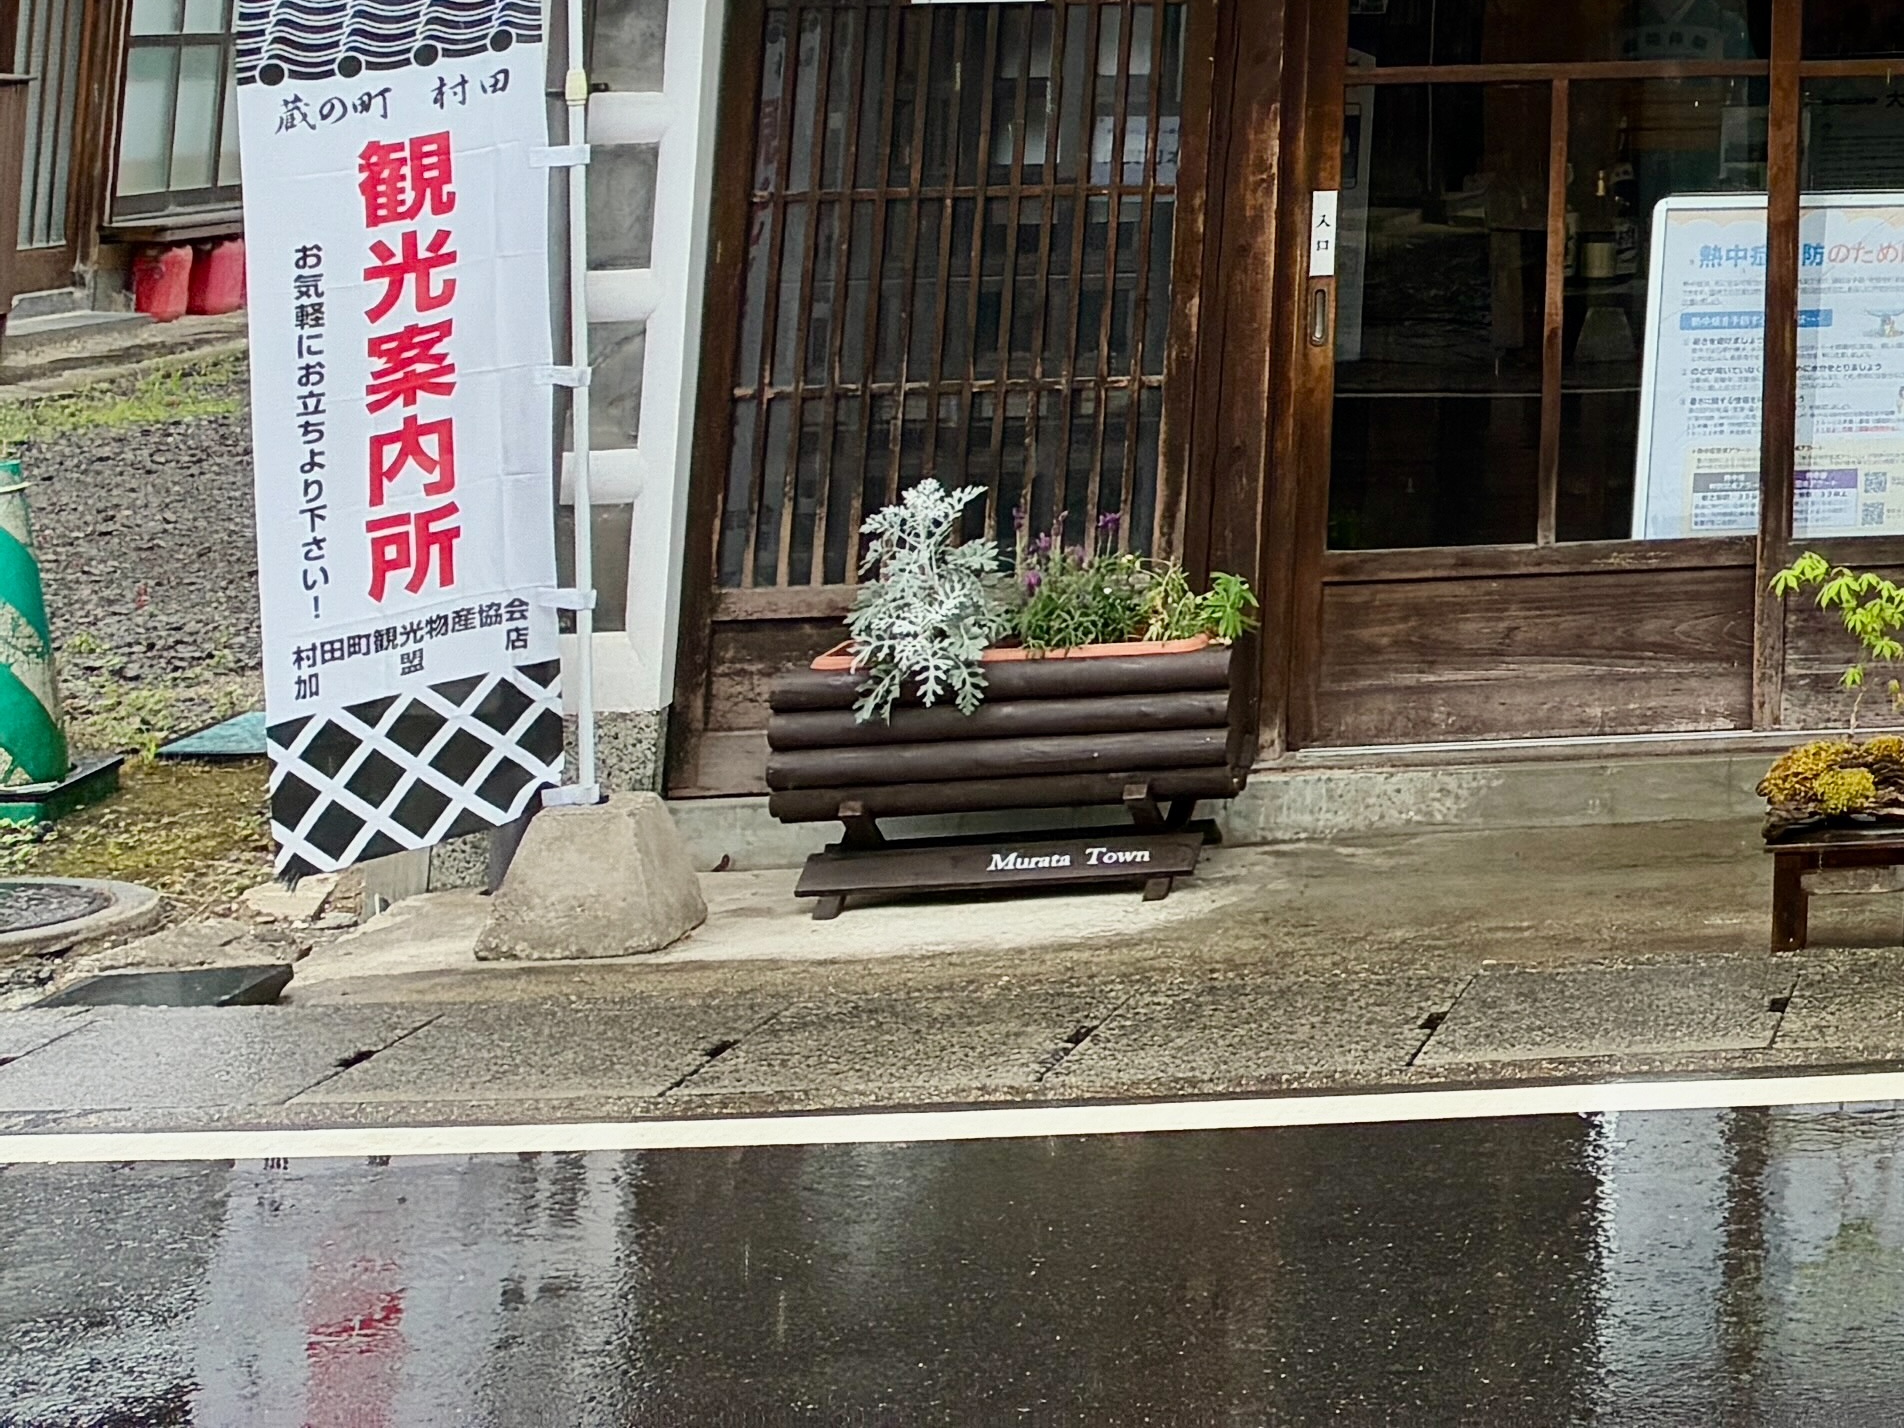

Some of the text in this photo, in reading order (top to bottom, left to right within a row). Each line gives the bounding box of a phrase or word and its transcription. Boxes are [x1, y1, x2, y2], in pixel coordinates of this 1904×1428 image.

[275, 68, 510, 133] 蔵の町 村田
[1316, 214, 1330, 251] 入口
[357, 129, 462, 604] 観光案内所
[292, 597, 529, 669] 村田町観光物産協会
[987, 848, 1149, 871] Murata Town
